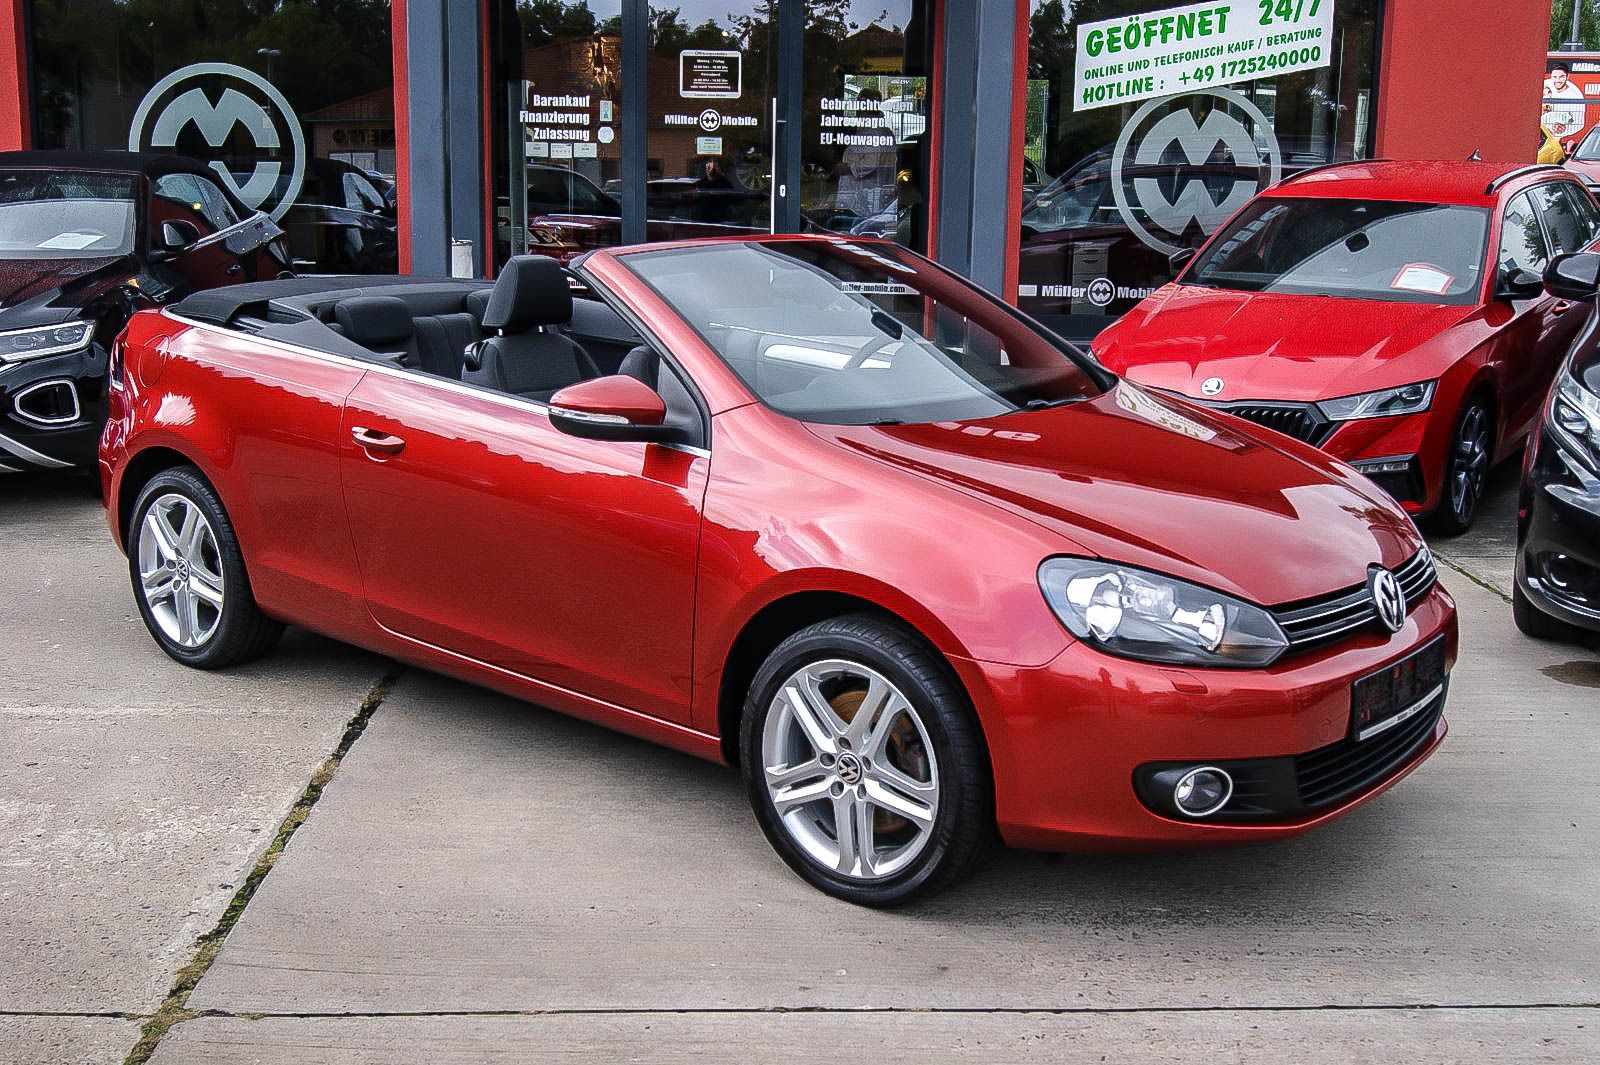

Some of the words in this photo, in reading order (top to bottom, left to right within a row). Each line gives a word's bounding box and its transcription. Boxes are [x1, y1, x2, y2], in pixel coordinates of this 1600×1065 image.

[1085, 6, 1231, 57] GEÖFFNET
[1259, 0, 1321, 26] 24/7
[1084, 63, 1124, 80] ONLINE
[1128, 59, 1150, 73] UND
[1154, 44, 1224, 68] TELEFONISCH
[1227, 39, 1255, 55] KAUF
[1266, 27, 1323, 47] BERATUNG
[1082, 76, 1154, 104] HOTLINE
[1178, 65, 1215, 86] +49
[1220, 45, 1321, 79] 1725240000
[533, 94, 591, 108] Barankauf
[519, 110, 590, 126] Finanzierung
[721, 116, 758, 126] Mobile
[533, 127, 590, 142] Zulassung
[820, 132, 894, 146] EU-Neuwagen
[1041, 284, 1087, 298] Müller
